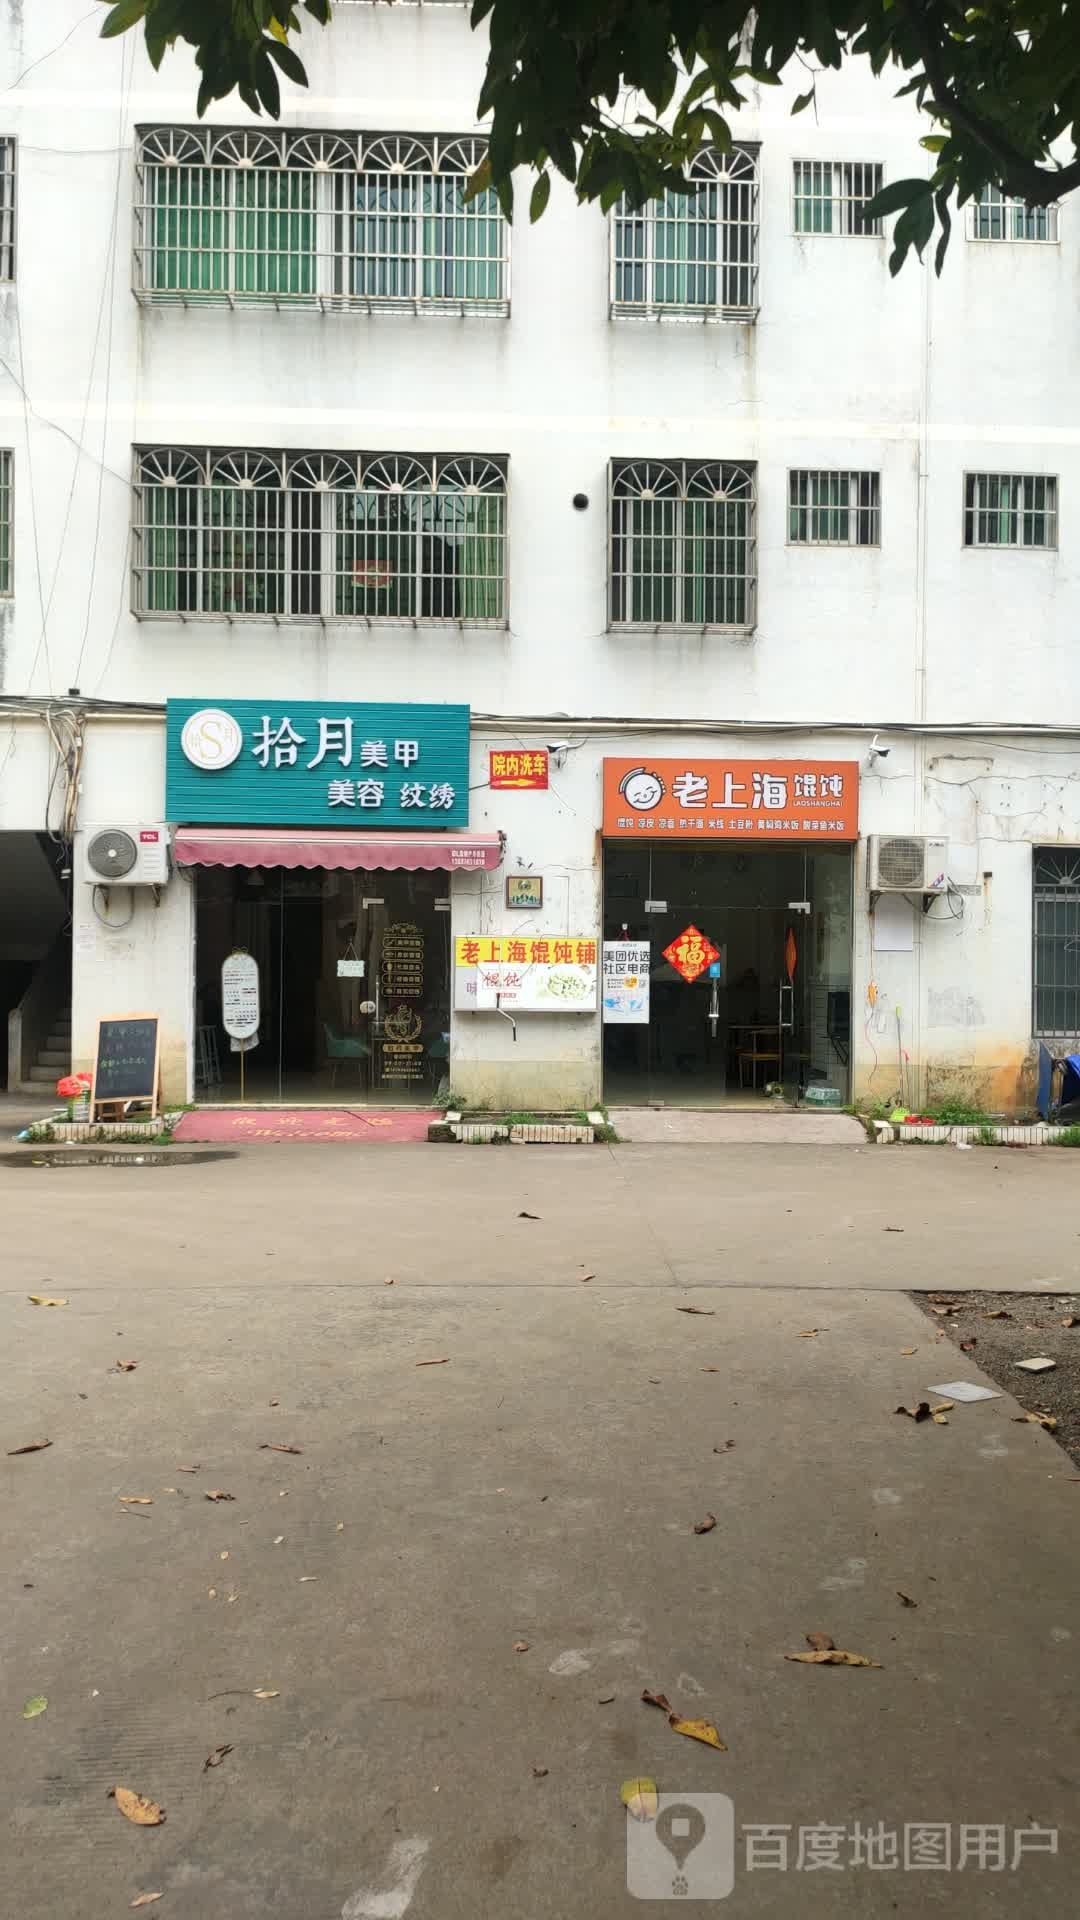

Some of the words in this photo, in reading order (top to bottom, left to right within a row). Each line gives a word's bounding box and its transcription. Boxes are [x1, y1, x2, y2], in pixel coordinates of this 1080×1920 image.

[251, 715, 354, 769] 拾月
[360, 740, 419, 768] 美甲
[492, 754, 547, 776] 院内洗车
[327, 779, 384, 807] 美容
[399, 782, 456, 809] 纹绣
[673, 771, 788, 809] 老上海
[793, 773, 843, 798] 馄饨
[461, 941, 596, 964] 老上海馄饨铺
[603, 950, 651, 961] 美团优选
[676, 935, 706, 964] 福
[603, 963, 651, 975] 社区电商
